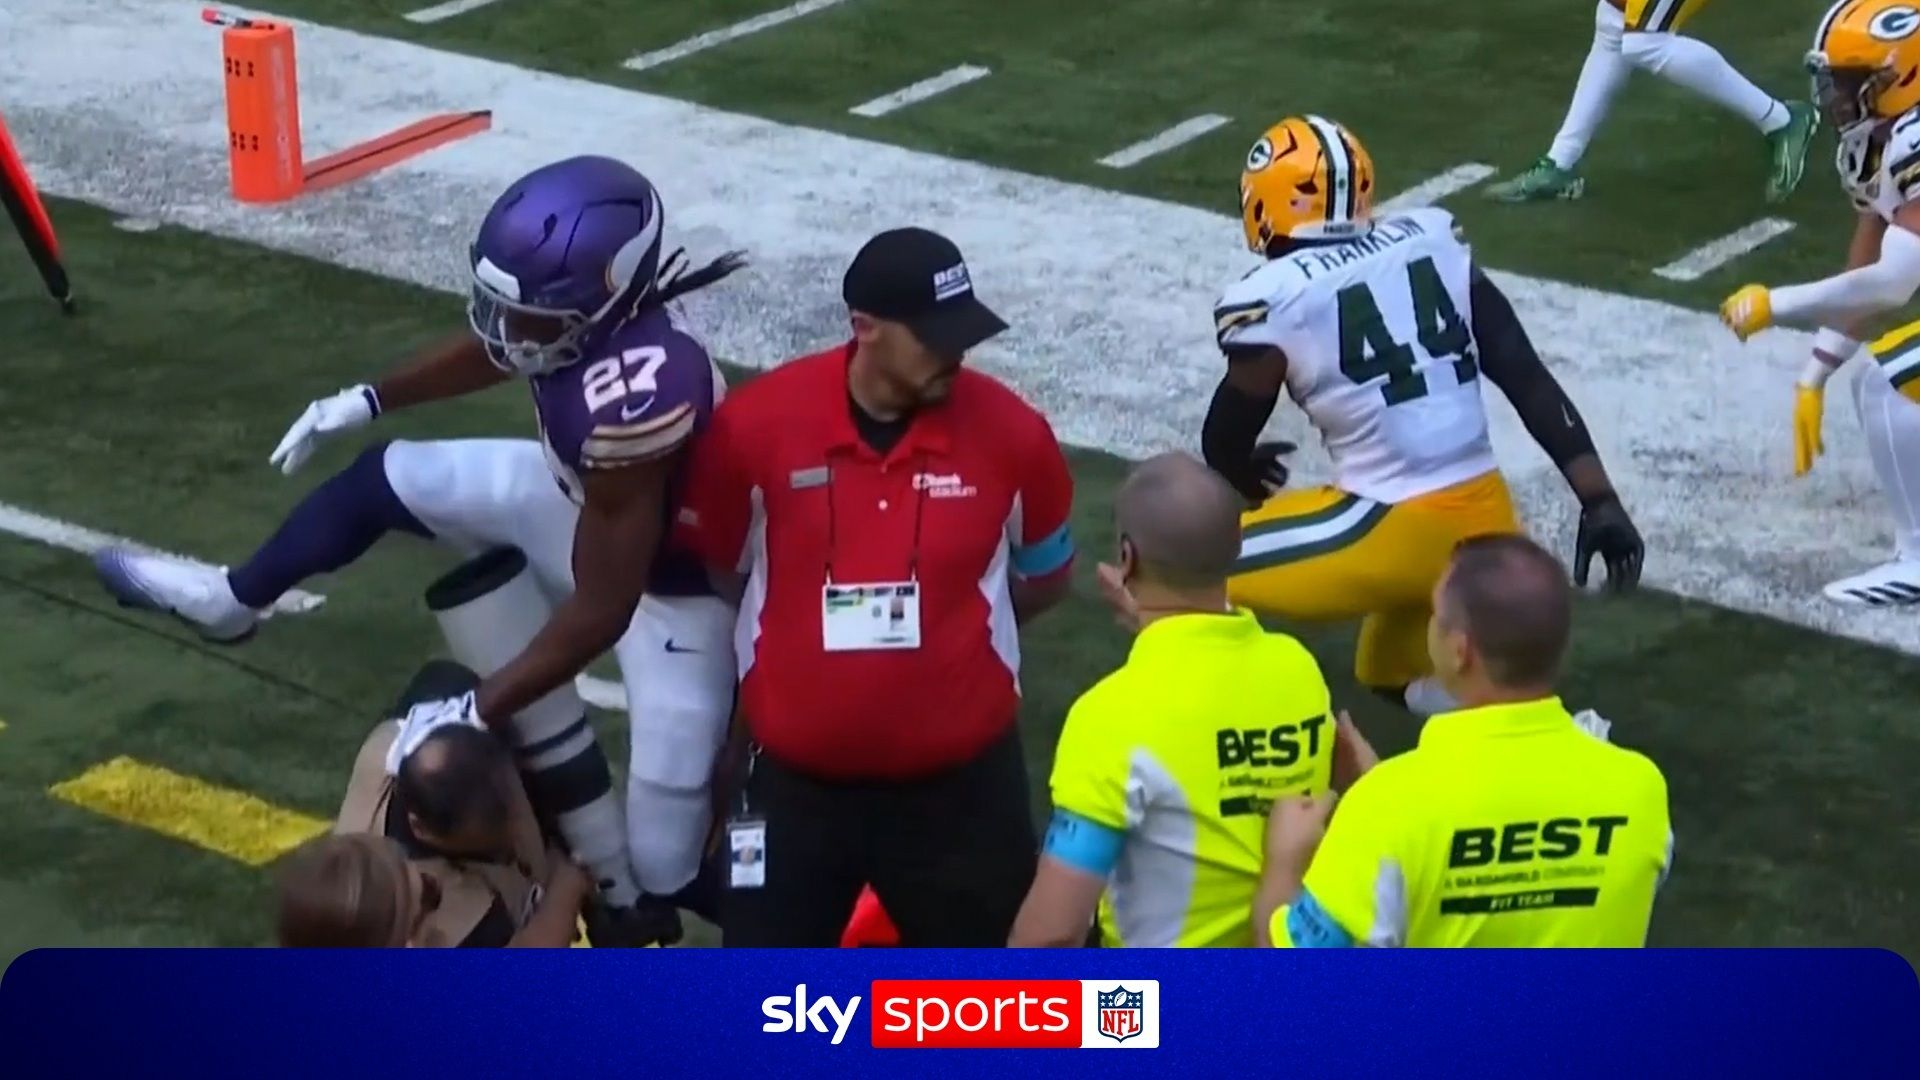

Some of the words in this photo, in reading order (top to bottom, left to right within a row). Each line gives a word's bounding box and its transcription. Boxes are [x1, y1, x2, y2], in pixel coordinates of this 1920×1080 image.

[1293, 215, 1425, 280] FRANKLIN
[1337, 255, 1478, 408] 44
[583, 345, 667, 414] 27
[1216, 714, 1326, 769] BEST
[1448, 816, 1629, 868] BEST
[1518, 891, 1555, 907] TEAM
